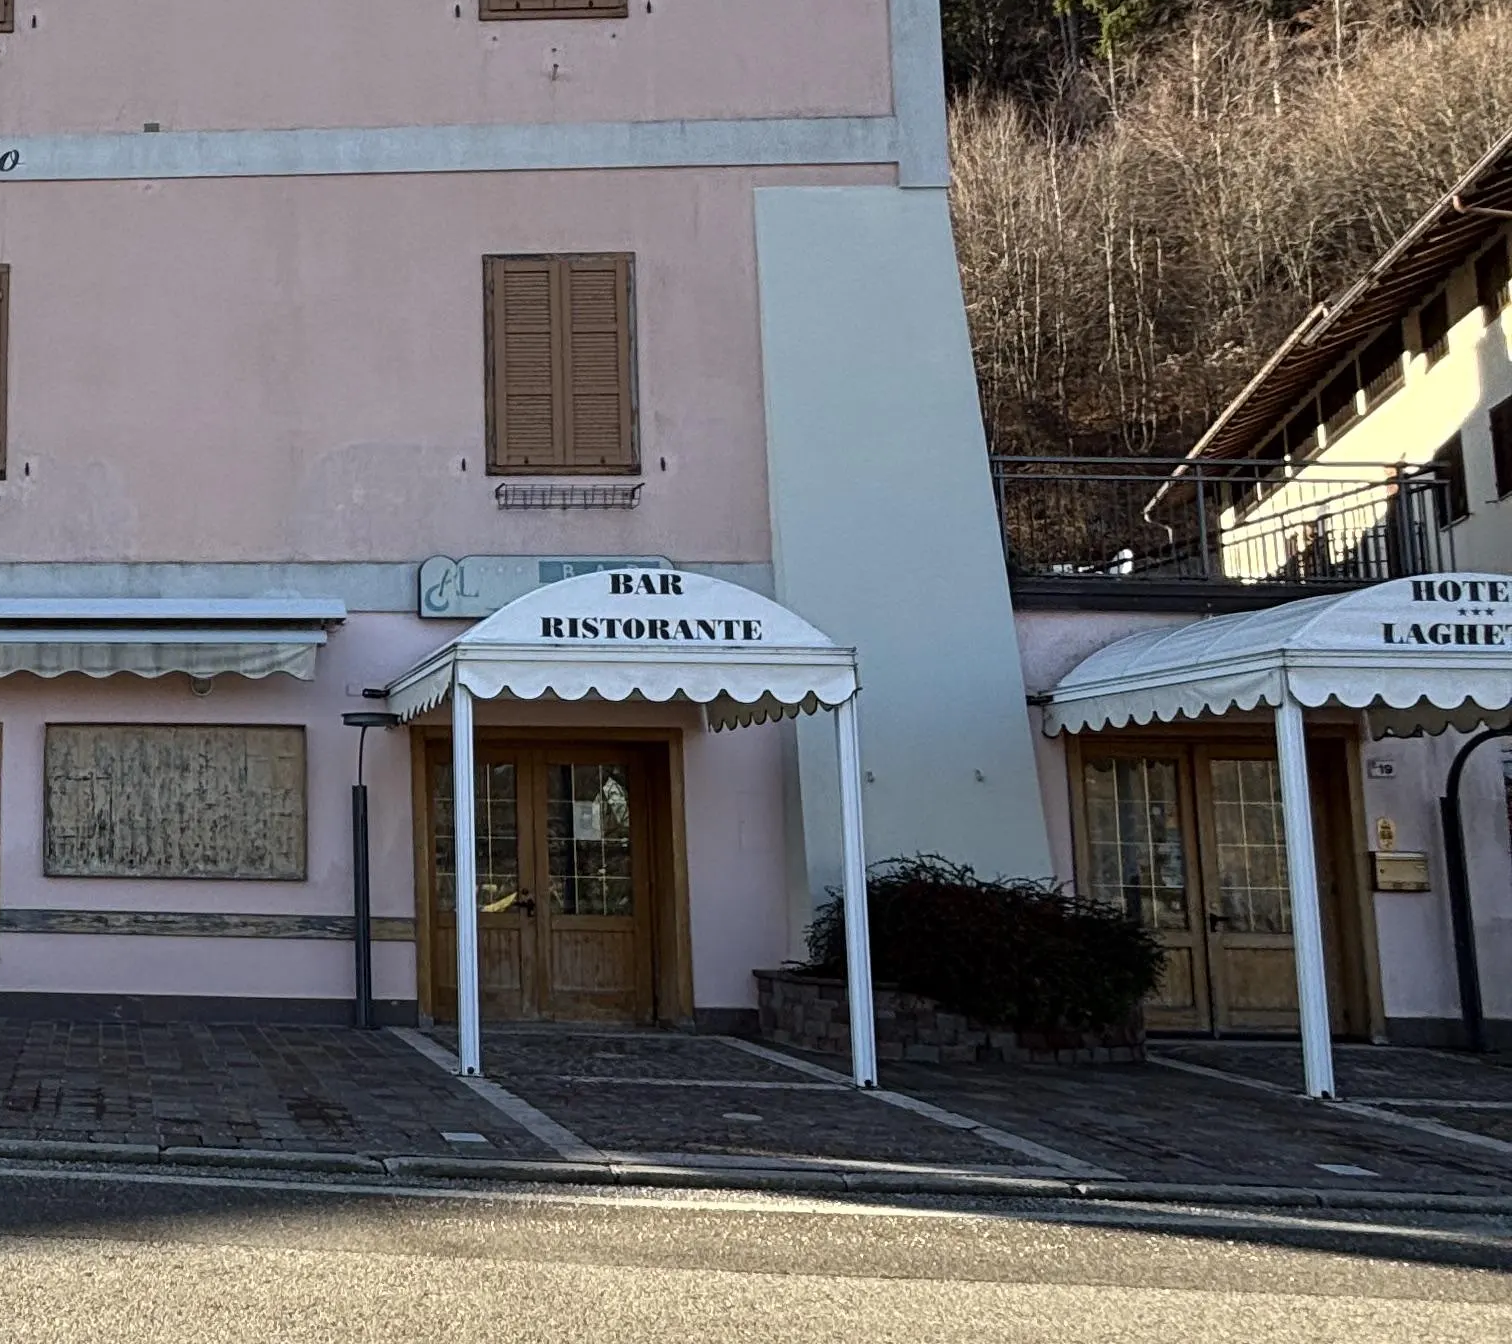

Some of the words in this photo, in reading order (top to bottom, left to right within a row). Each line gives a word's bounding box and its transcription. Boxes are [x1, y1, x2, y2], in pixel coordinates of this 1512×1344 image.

[609, 573, 684, 595] BAR
[1411, 580, 1512, 602] HOTE
[540, 617, 763, 641] RISTORANTE
